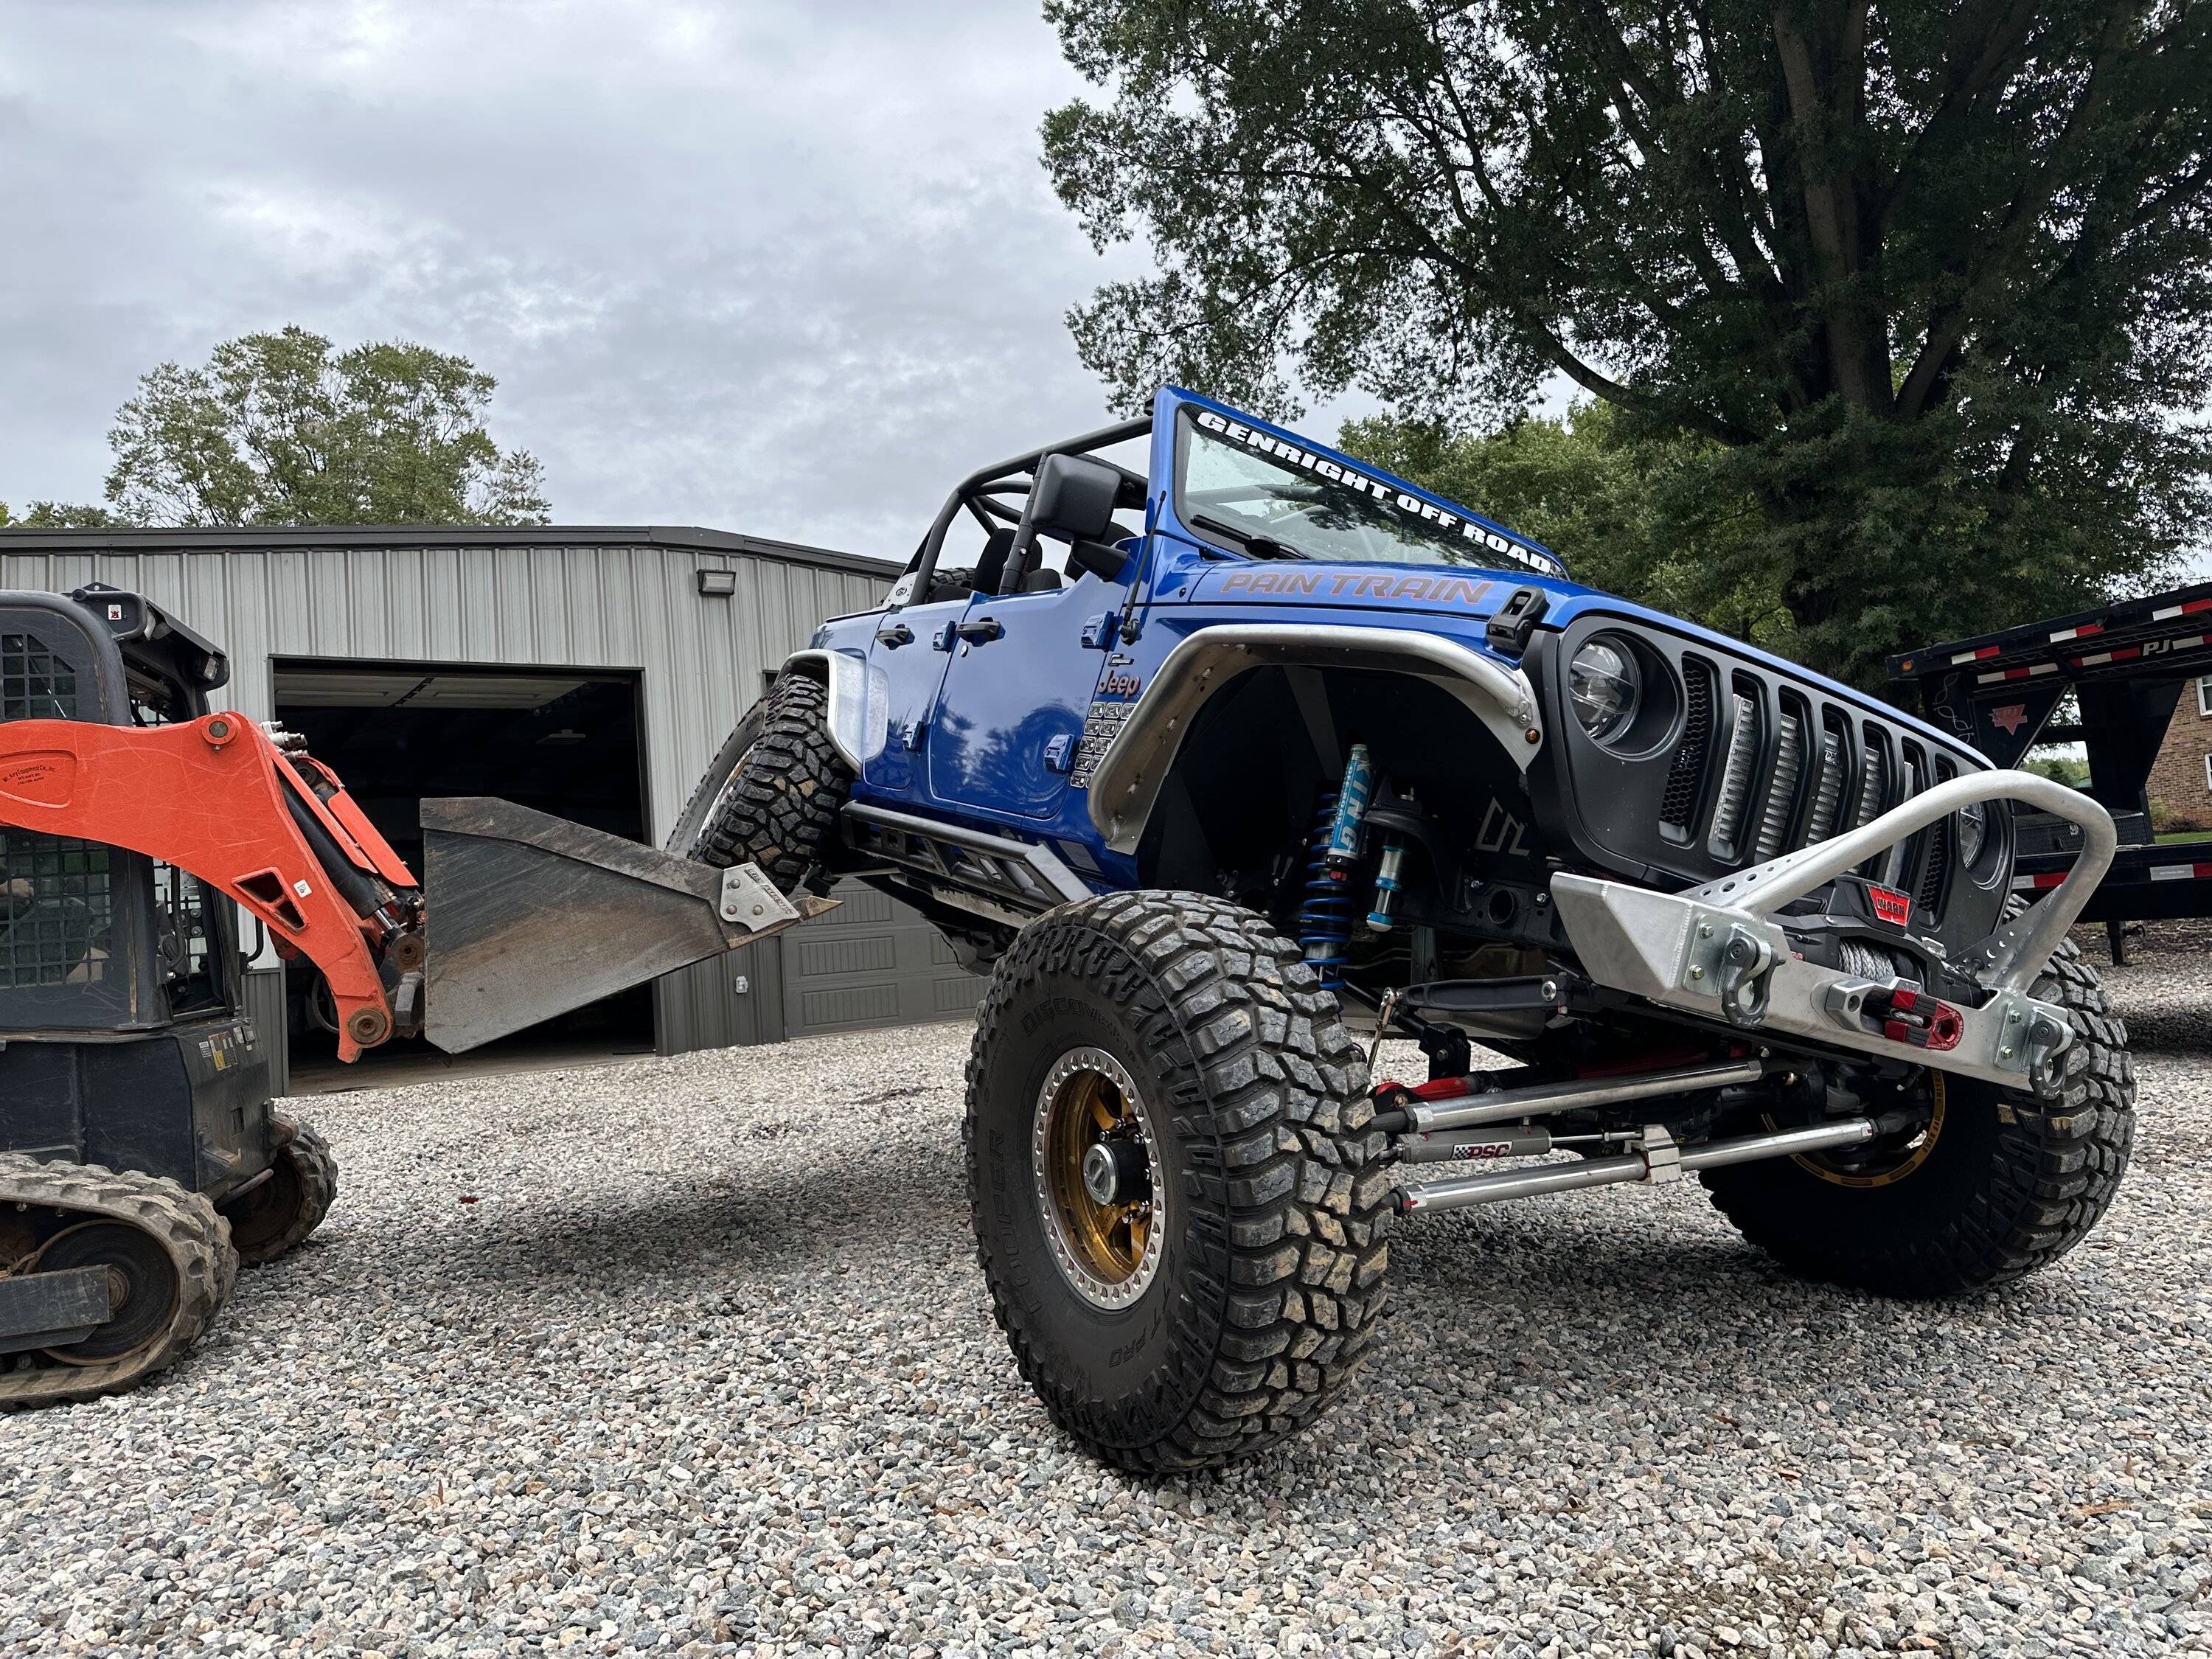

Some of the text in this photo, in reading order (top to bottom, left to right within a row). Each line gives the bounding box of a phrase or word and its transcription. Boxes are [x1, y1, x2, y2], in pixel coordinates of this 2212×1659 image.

[1197, 411, 1551, 573] GENRIGHT OFF ROAD
[1220, 572, 1495, 605] PAIN TRAIN
[2143, 639, 2170, 655] PJ
[1097, 670, 1141, 700] Jeep
[1340, 762, 1372, 852] KING
[1877, 897, 1905, 917] WARN
[1468, 1144, 1510, 1158] PSC
[1107, 1324, 1147, 1368] PRO
